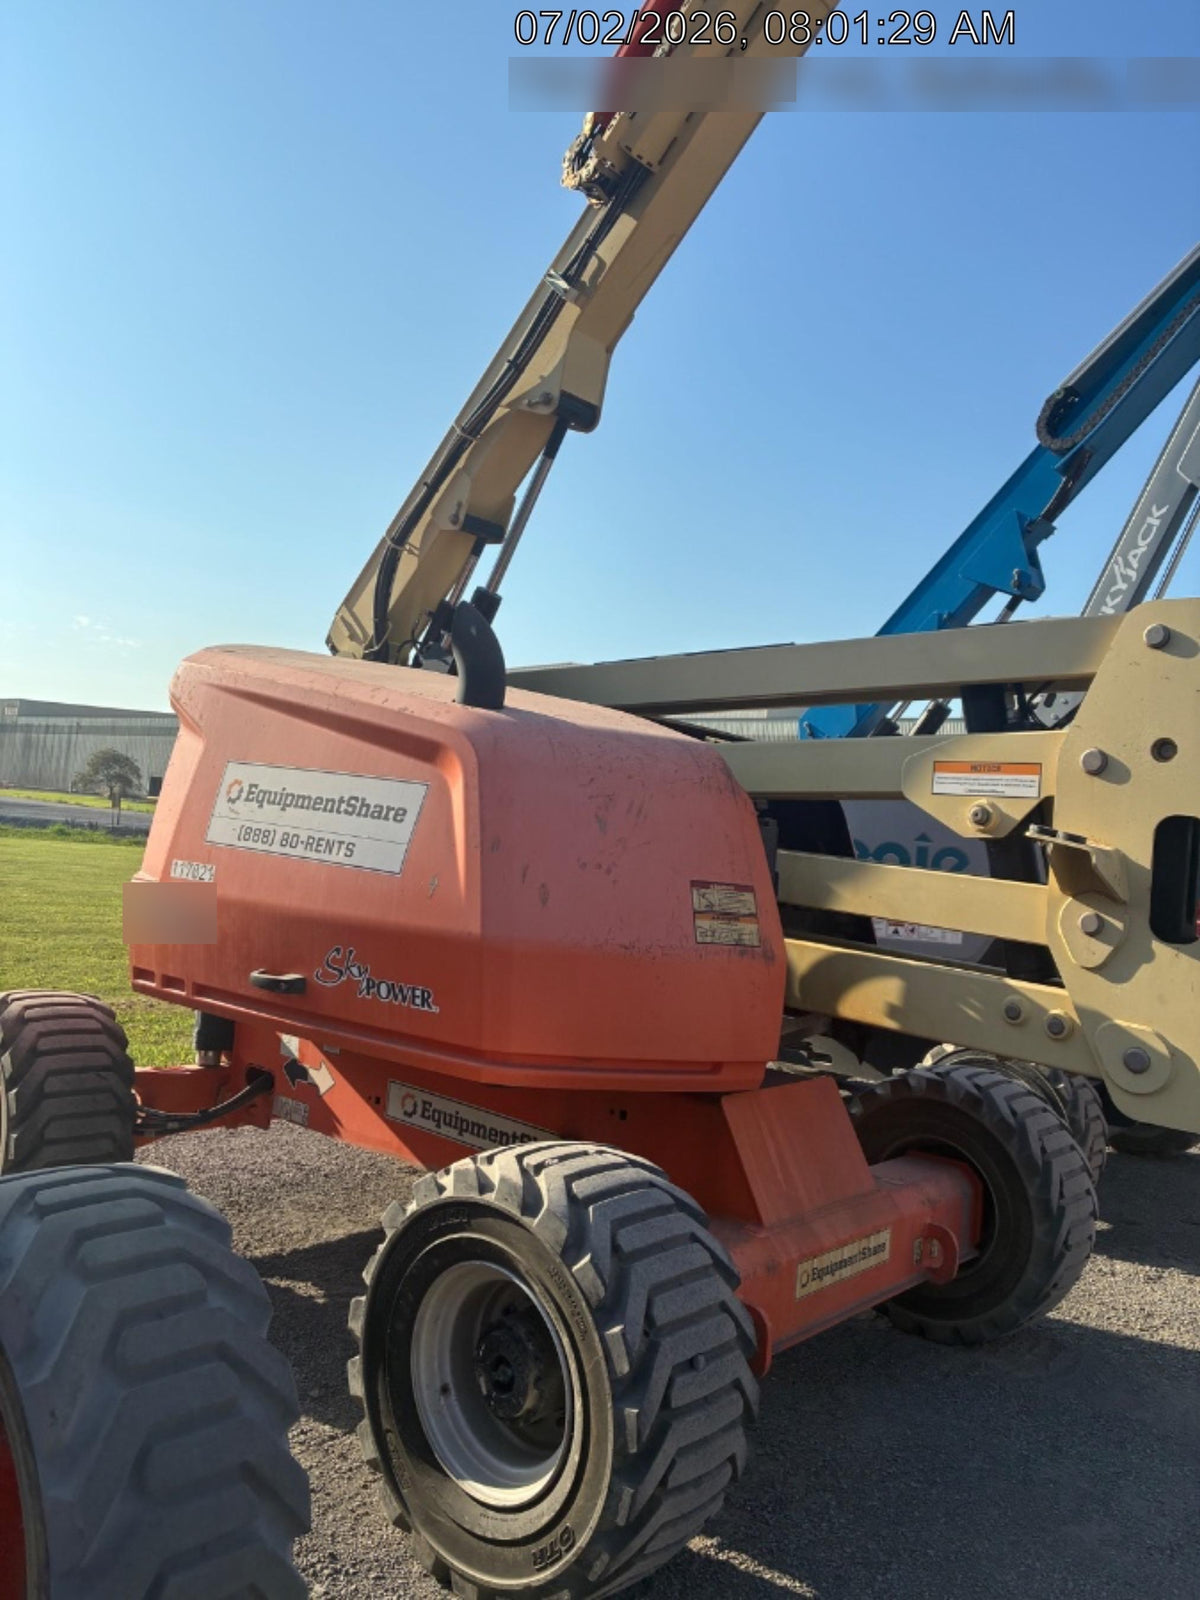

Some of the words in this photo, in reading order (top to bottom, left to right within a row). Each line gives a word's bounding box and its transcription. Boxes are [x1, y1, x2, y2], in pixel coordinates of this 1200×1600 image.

[1098, 504, 1169, 615] KYJACK
[243, 783, 408, 824] EquipmentShare
[237, 824, 277, 848] (888)
[280, 832, 356, 858] 80-RENTS
[854, 832, 969, 872] nie
[314, 946, 370, 998] Sky
[364, 977, 436, 1012] POWER
[810, 1242, 887, 1282] EquipmentShare
